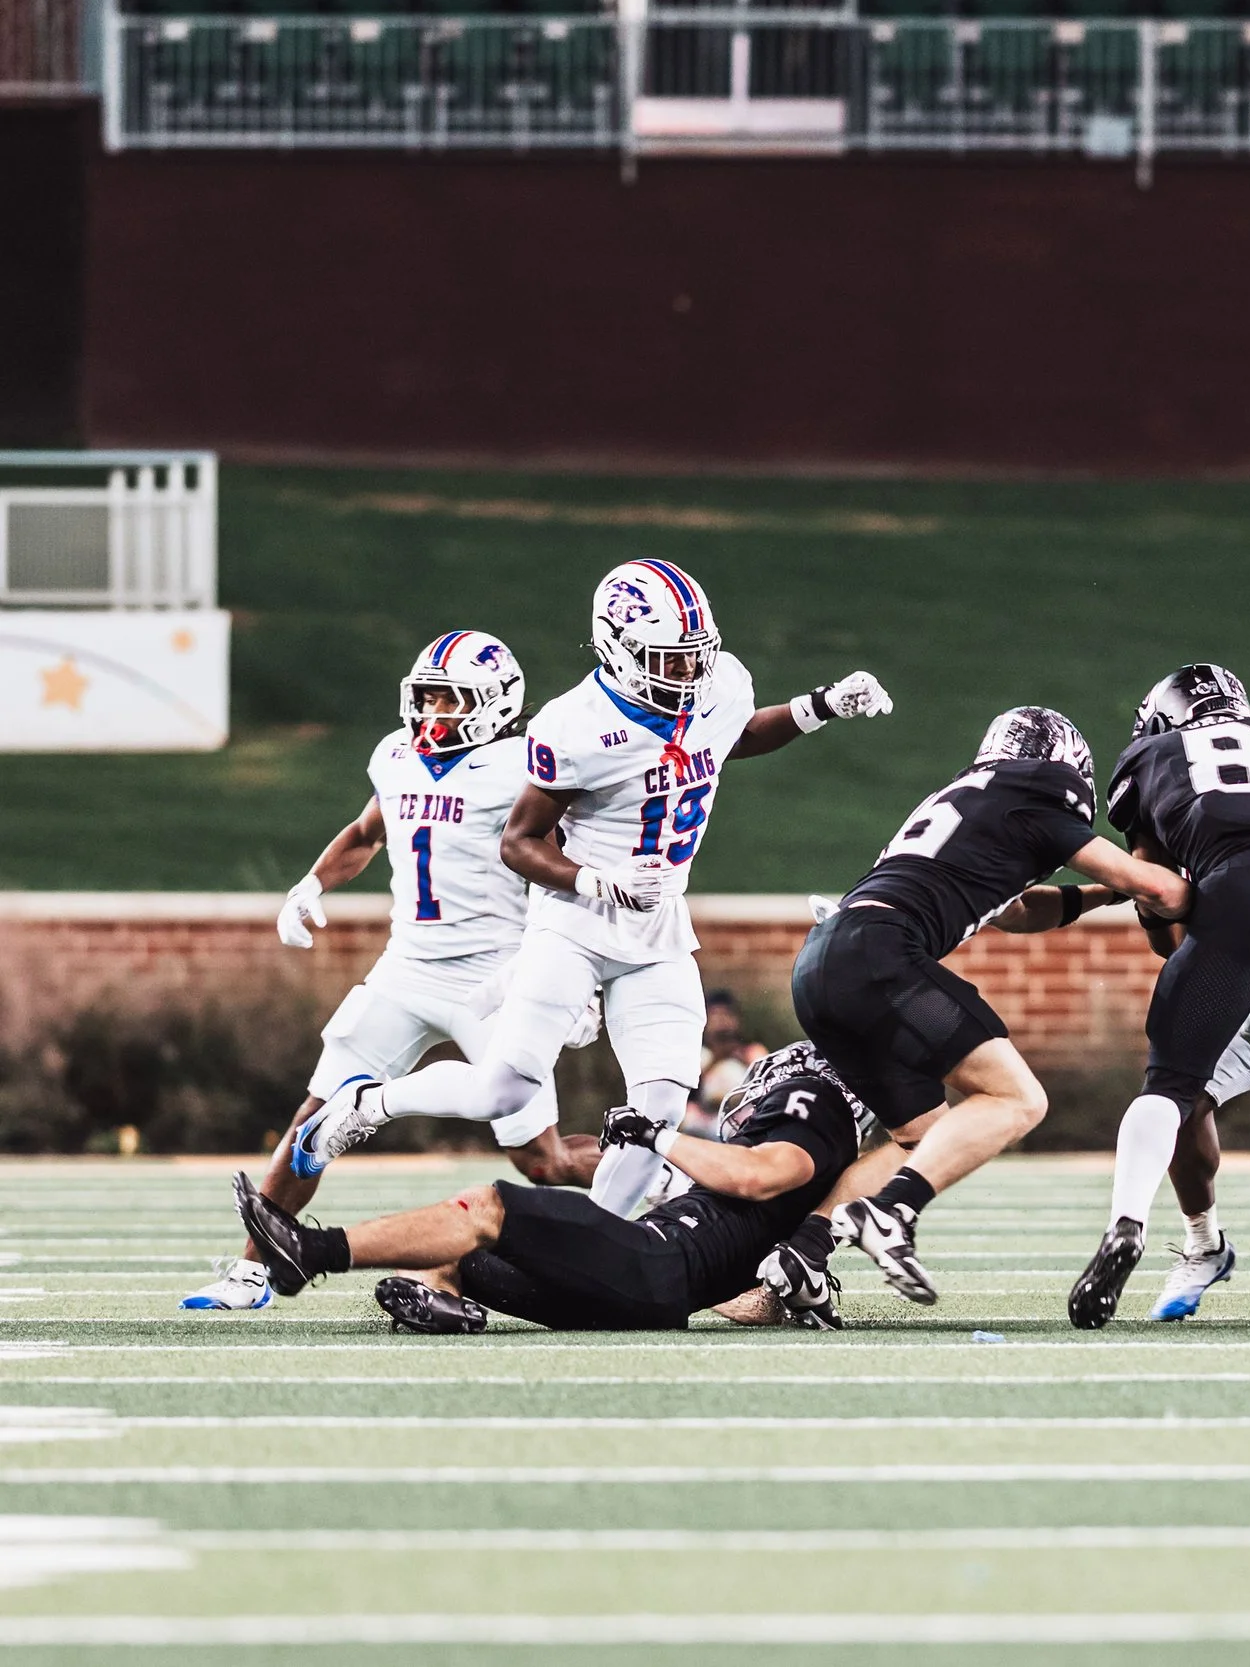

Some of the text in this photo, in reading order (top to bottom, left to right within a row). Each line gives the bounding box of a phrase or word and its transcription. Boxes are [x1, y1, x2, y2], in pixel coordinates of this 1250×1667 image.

[527, 735, 557, 783] 19
[600, 729, 628, 748] WAO
[644, 763, 671, 794] CE
[400, 794, 464, 824] CE KING
[631, 782, 712, 867] 19
[874, 770, 996, 868] 6
[411, 825, 442, 921] 1
